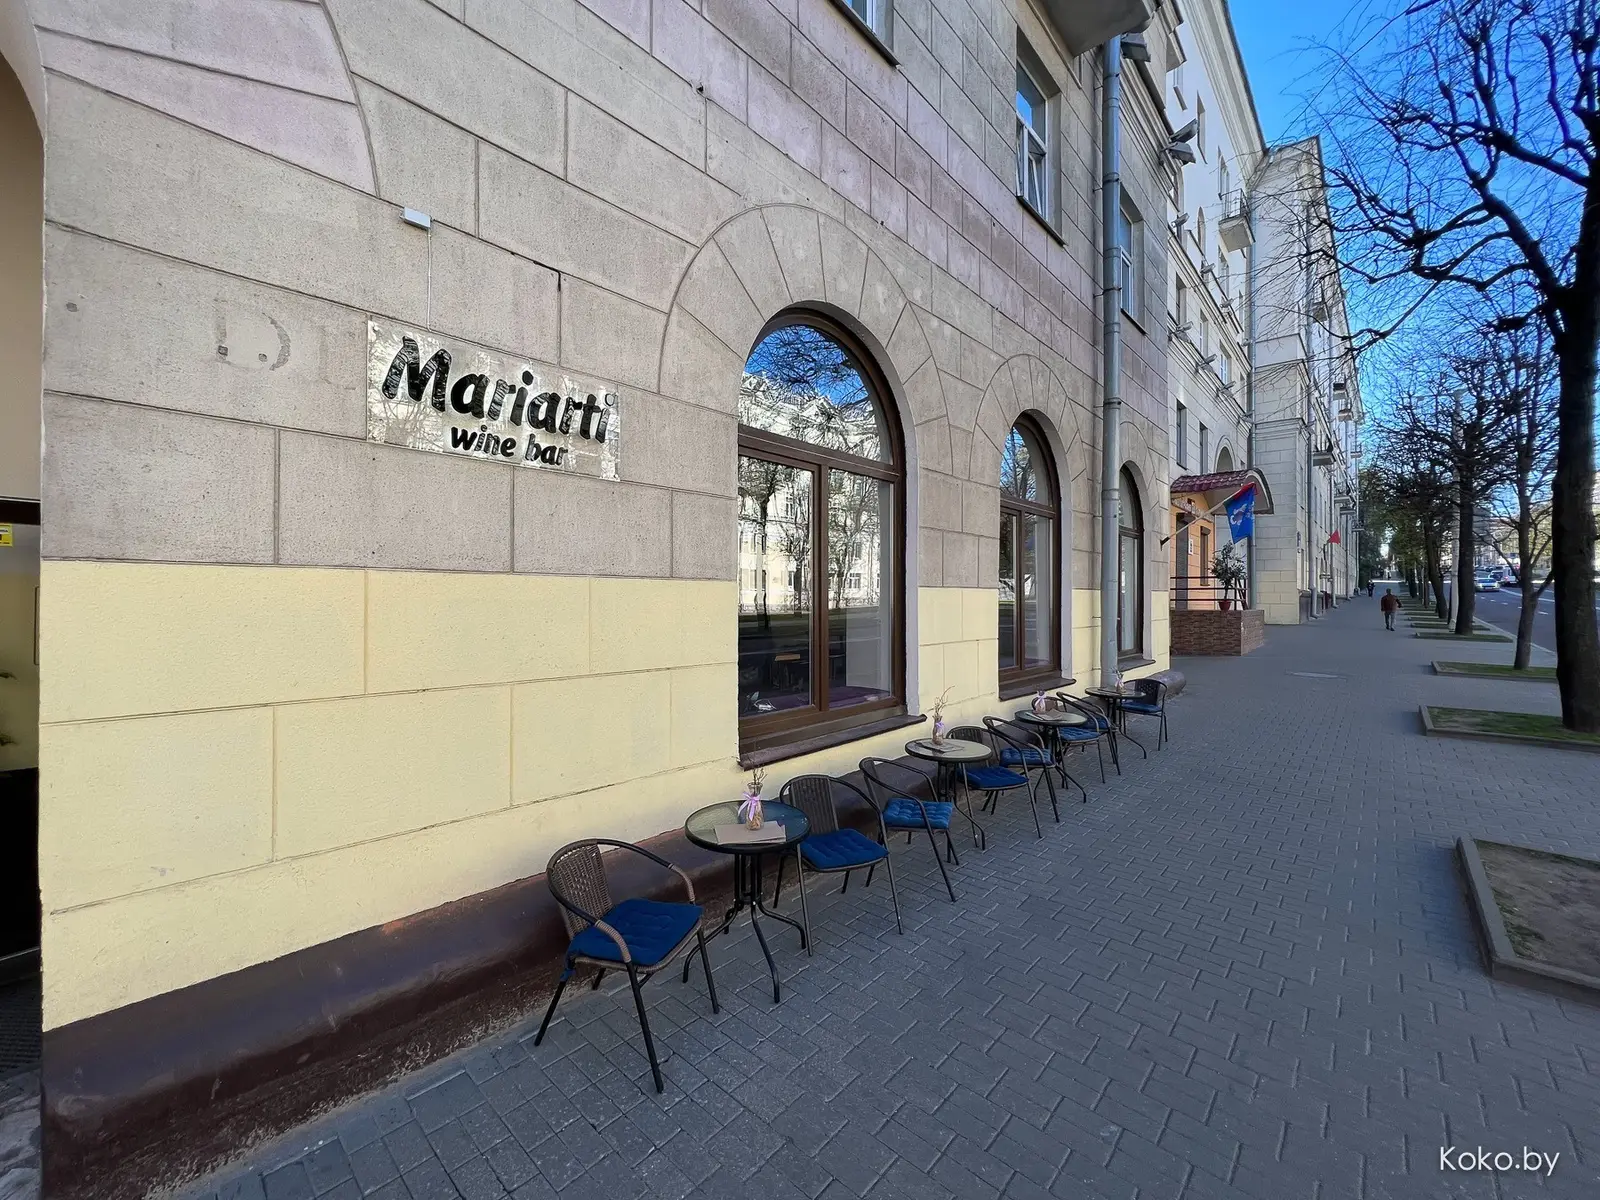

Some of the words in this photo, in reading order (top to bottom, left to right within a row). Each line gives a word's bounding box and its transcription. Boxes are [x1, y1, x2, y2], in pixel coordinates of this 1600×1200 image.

[382, 336, 615, 443] Mariarti
[450, 425, 517, 457] wine
[524, 433, 569, 466] bar
